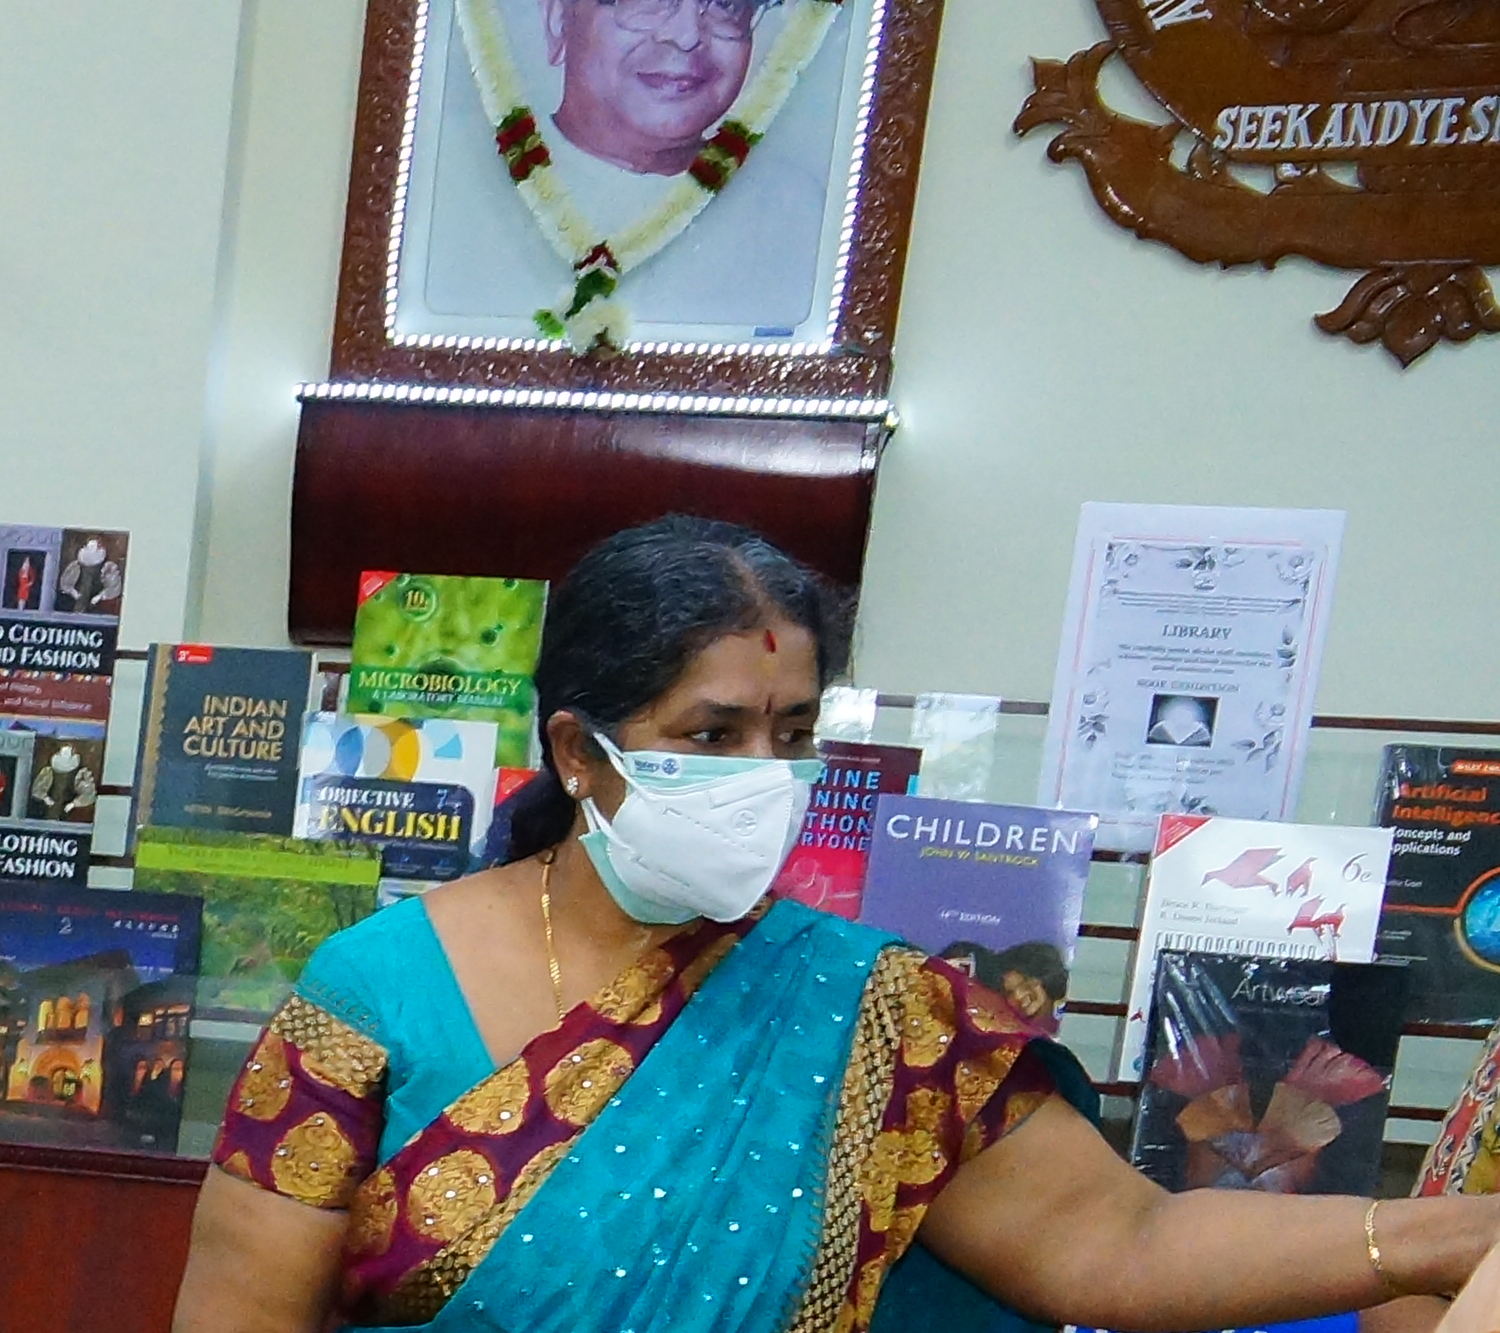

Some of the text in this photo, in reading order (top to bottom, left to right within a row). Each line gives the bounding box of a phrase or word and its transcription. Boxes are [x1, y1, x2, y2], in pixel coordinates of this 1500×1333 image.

[8, 624, 103, 648] CLOTHING
[1162, 624, 1232, 640] LIBRARY
[20, 646, 101, 669] FASHION
[358, 670, 522, 697] MICROBIOLOGY
[203, 694, 288, 718] INDIAN
[184, 716, 285, 740] ART AND
[183, 736, 283, 761] CULTURE
[318, 786, 415, 809] OBJECTIVE
[1400, 782, 1487, 801] Artificial
[318, 803, 461, 841] ENGLISH
[886, 814, 1078, 855] CHILDREN
[1393, 826, 1471, 843] oncepts and
[1393, 841, 1461, 857] pplications
[59, 917, 72, 934] 2
